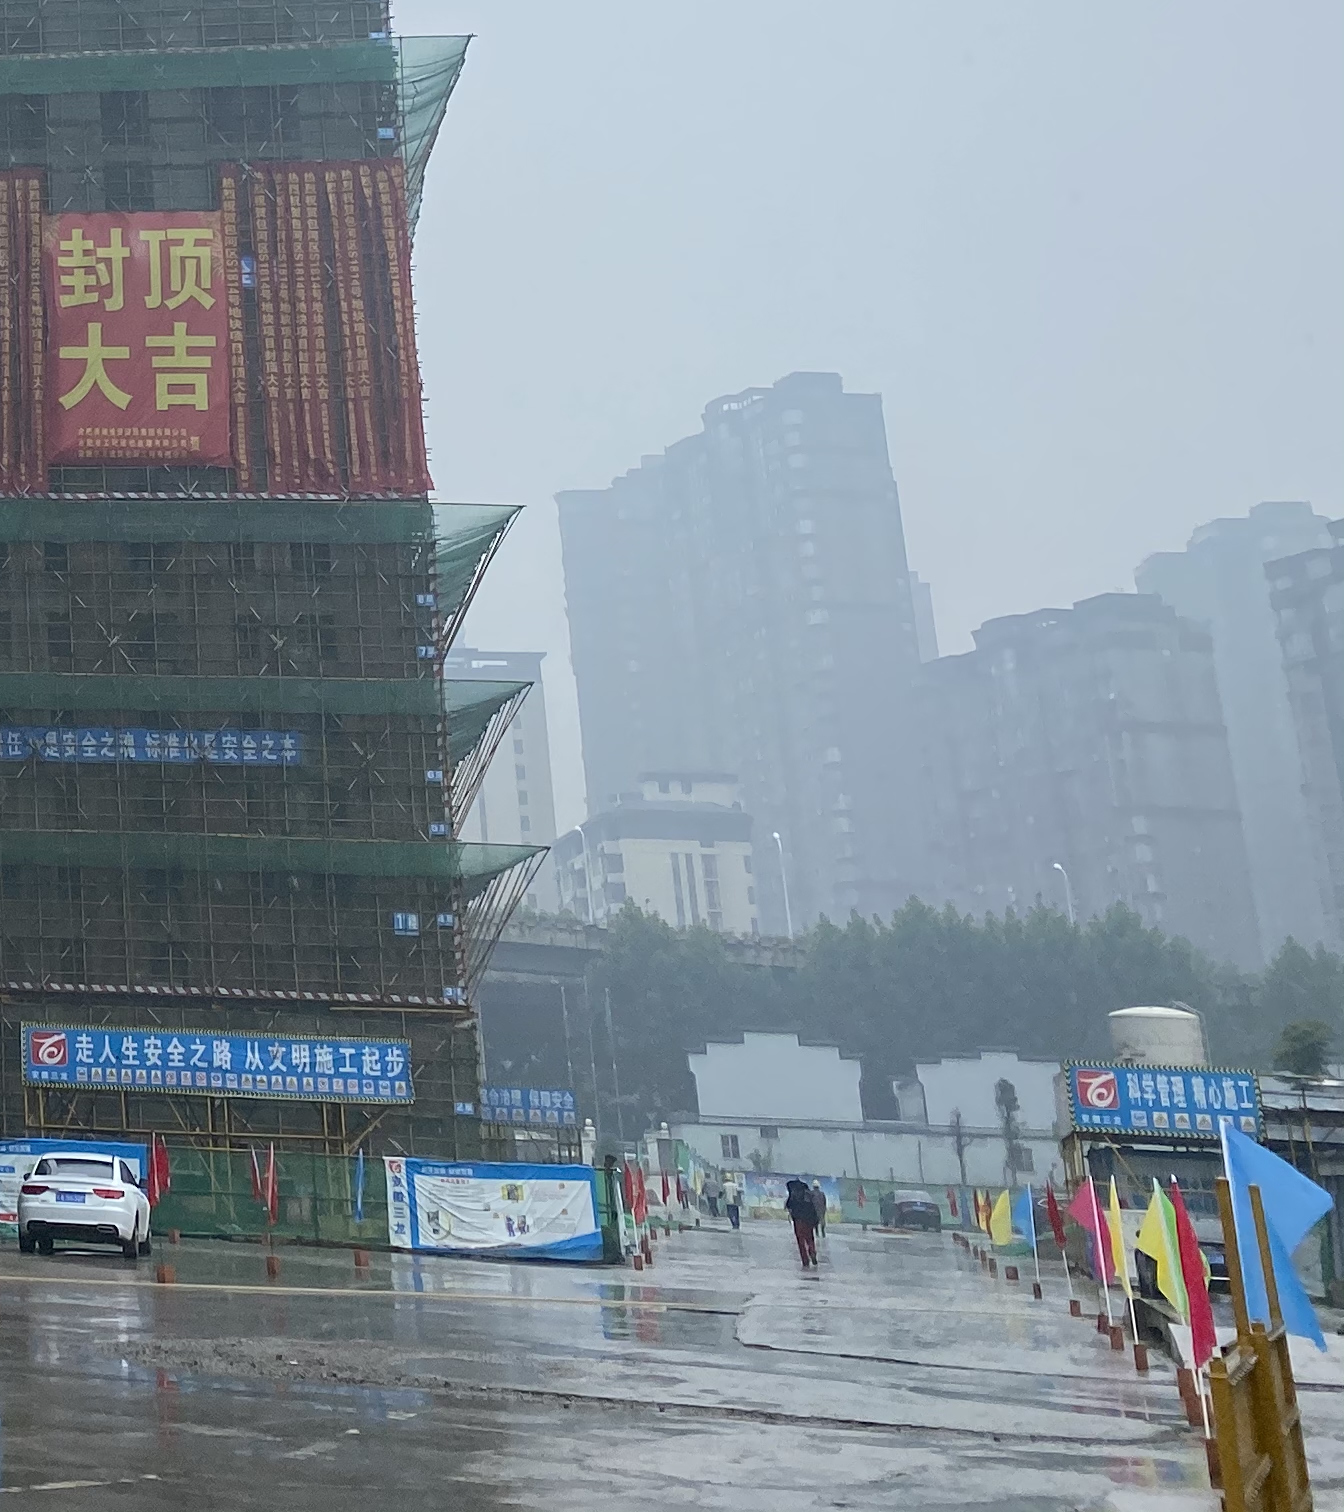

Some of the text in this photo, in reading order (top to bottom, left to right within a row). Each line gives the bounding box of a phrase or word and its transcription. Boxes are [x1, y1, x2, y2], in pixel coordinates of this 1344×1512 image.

[58, 227, 216, 313] 封顶
[59, 322, 218, 412] 大吉
[75, 1032, 405, 1078] 走人生安全之路 从文明施工起步
[1126, 1073, 1254, 1111] 科学管理 精心施工
